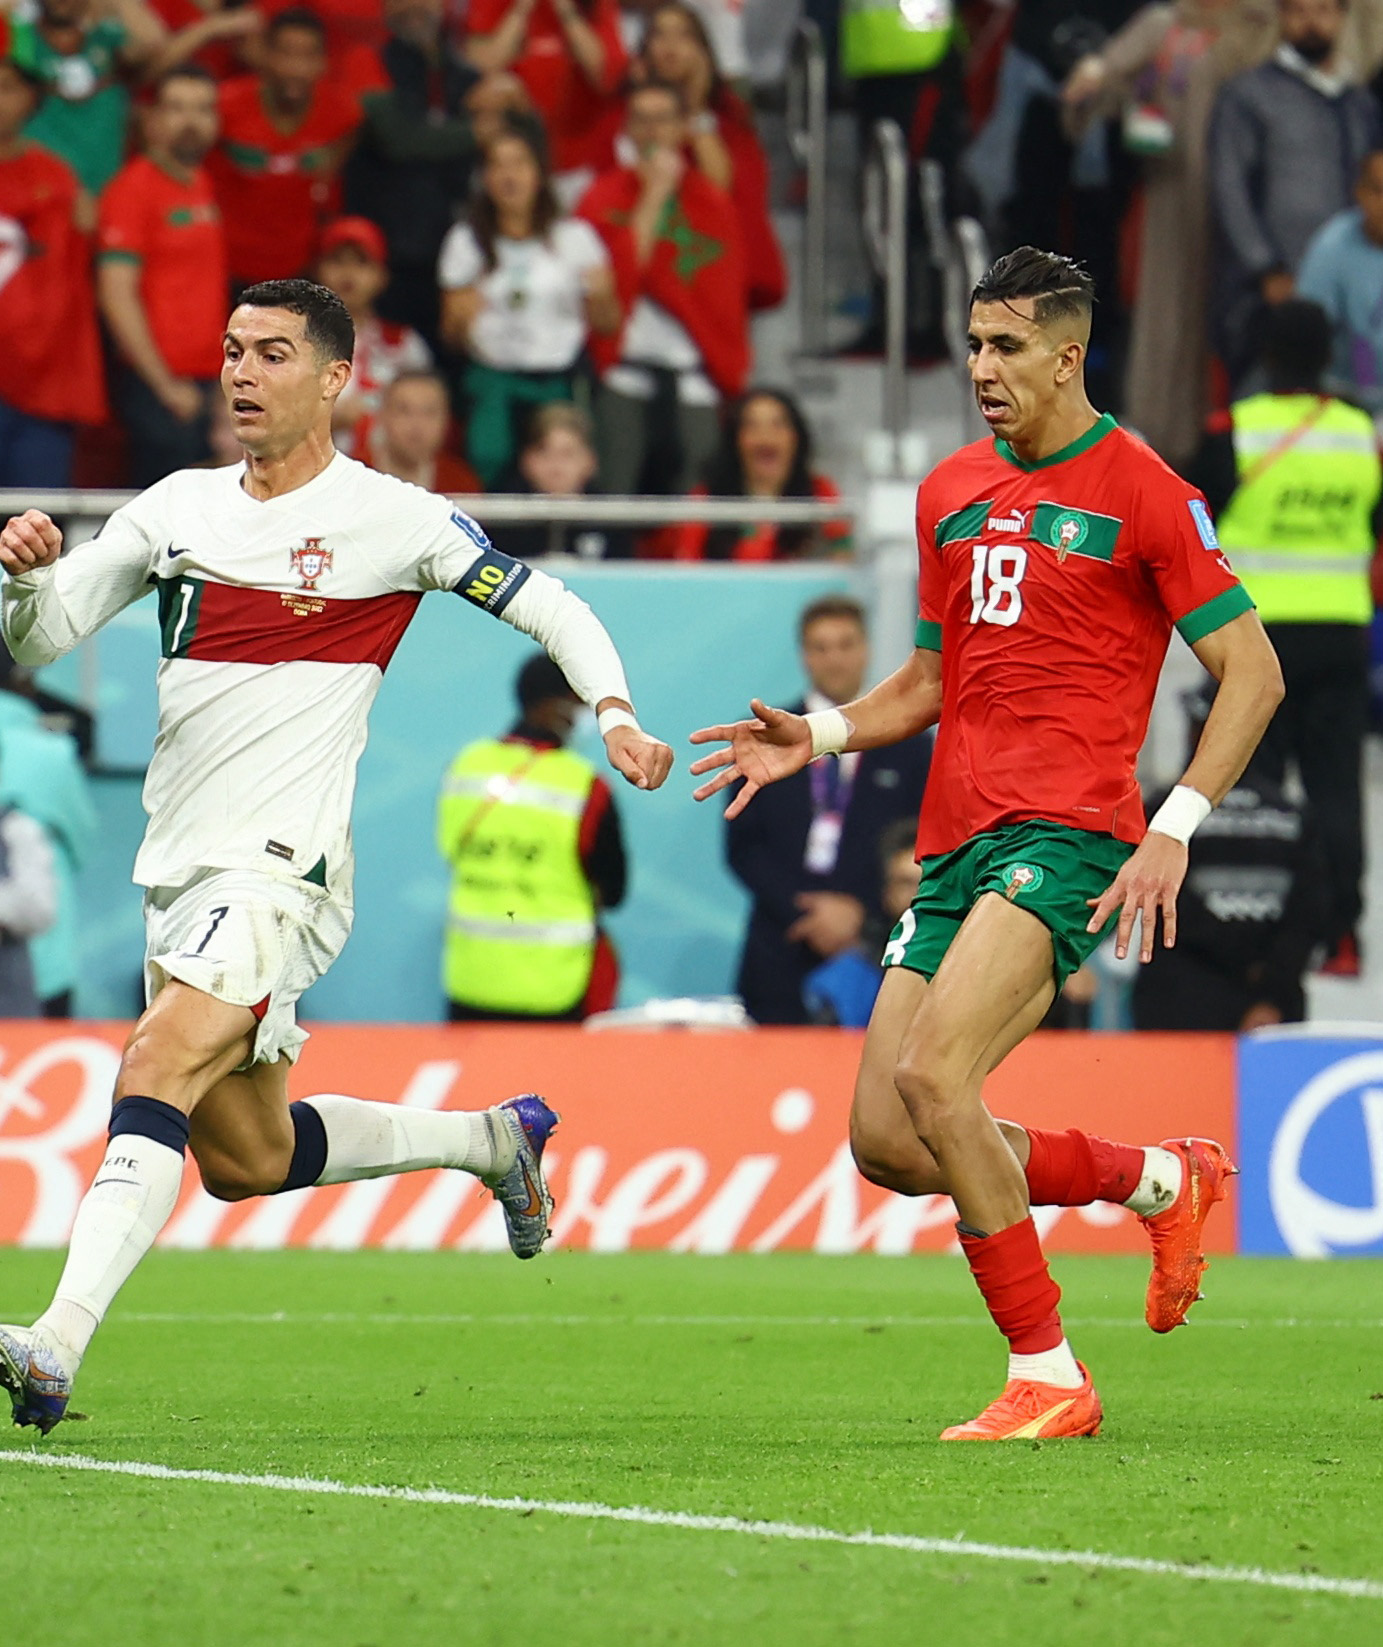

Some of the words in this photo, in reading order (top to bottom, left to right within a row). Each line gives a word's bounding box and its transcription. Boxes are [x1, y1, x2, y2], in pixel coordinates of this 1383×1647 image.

[987, 517, 1022, 533] PUMA
[465, 565, 505, 602] NO
[969, 545, 1027, 627] 18
[196, 905, 229, 954] 7
